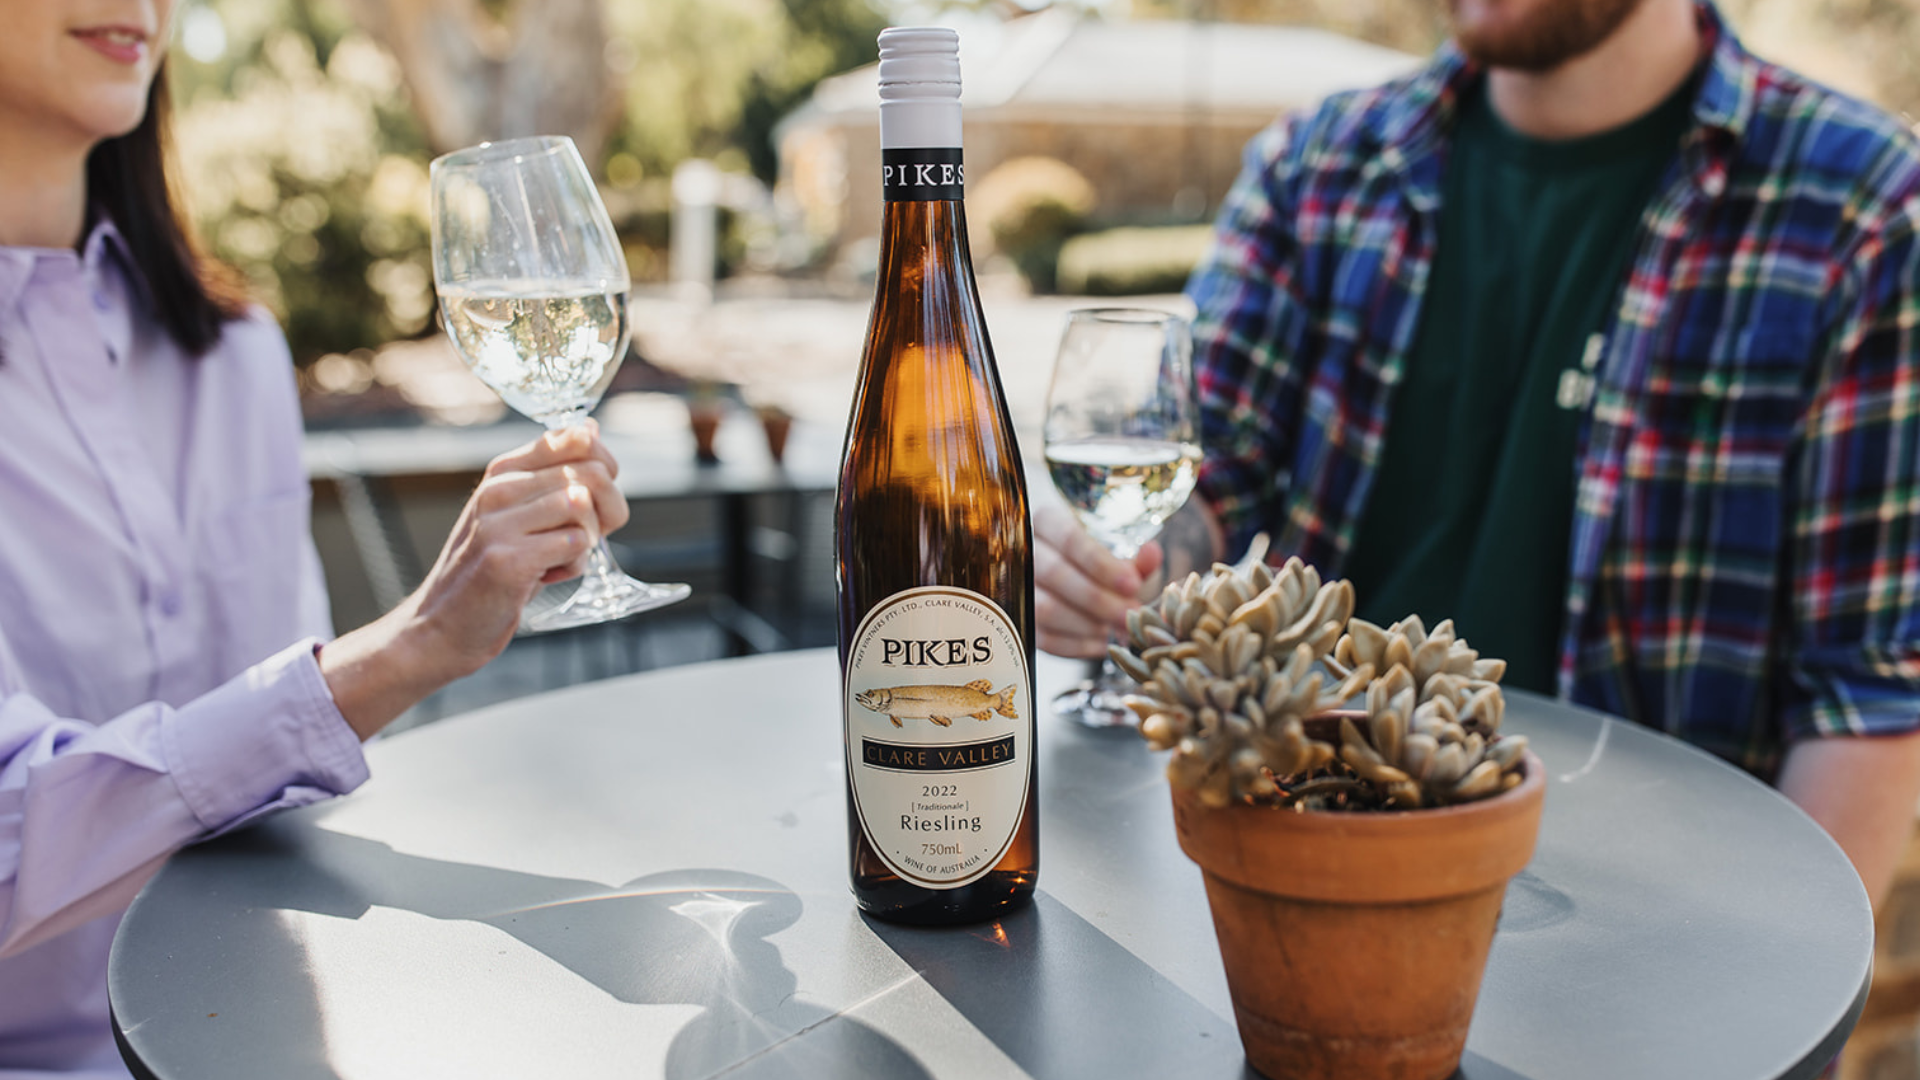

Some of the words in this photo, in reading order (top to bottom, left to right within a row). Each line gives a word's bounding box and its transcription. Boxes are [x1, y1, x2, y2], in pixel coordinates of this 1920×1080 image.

[883, 164, 964, 186] PIKES
[863, 619, 886, 648] VINTNERS
[881, 636, 992, 666] PIKES
[866, 745, 927, 766] CLARE
[938, 742, 1011, 765] VALLEY
[922, 785, 957, 797] 2022
[901, 815, 982, 832] Riesling
[921, 843, 962, 855] 750mL
[904, 856, 924, 871] WINE
[940, 855, 980, 874] AUSTRALIA
